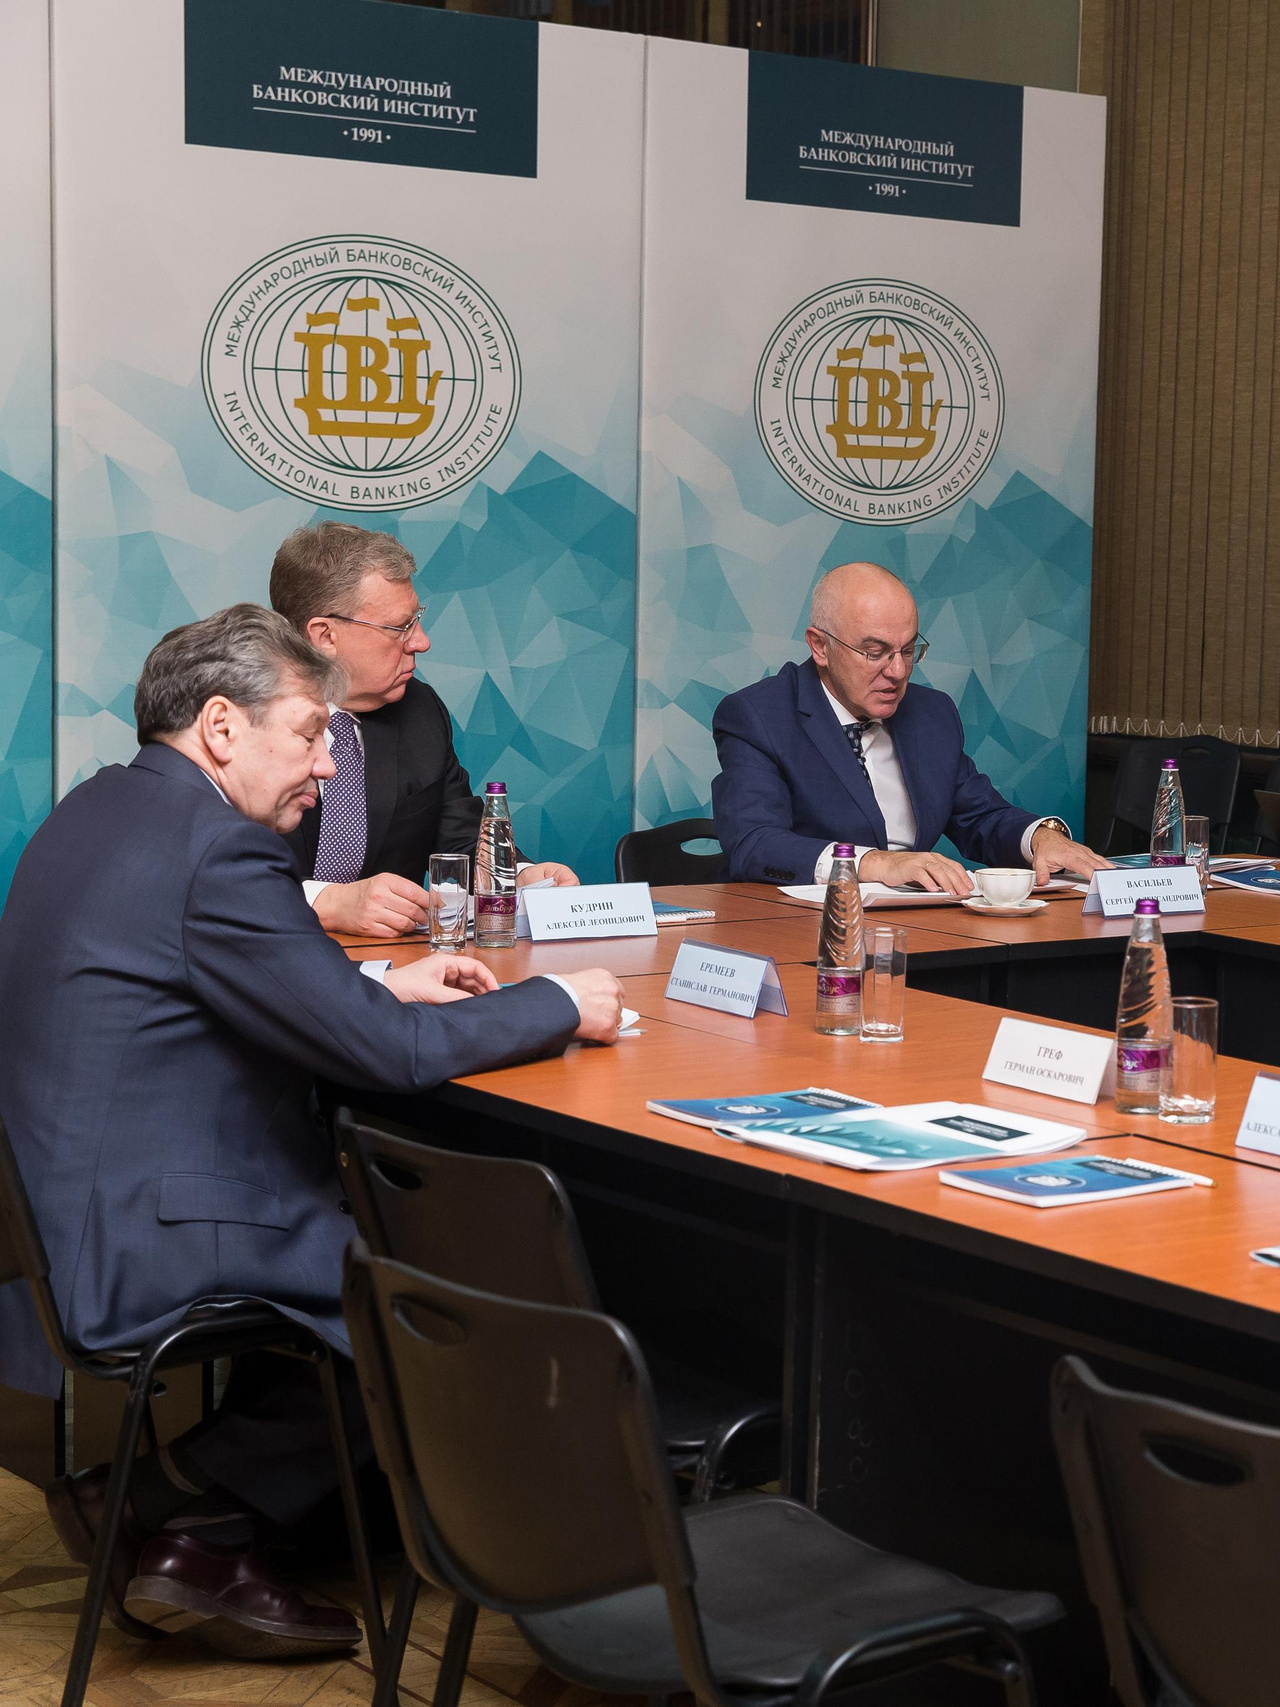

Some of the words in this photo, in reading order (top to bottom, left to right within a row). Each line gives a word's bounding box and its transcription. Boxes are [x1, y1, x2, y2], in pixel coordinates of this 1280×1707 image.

[278, 65, 453, 100] МЕЖДУНАРОДНЫЙ
[251, 84, 381, 112] БАНКОВСКИЙ
[382, 98, 478, 125] ИНСТИТУТ
[351, 127, 384, 144] 1991
[819, 129, 956, 158] МЕЖДУНАРОДНЫЙ
[799, 145, 898, 170] БАНКОВСКИЙ
[899, 157, 975, 180] ИНСТИТУТ
[874, 183, 901, 197] 1991
[223, 246, 342, 358] МЕЖДУНАРОДНЫЙ
[345, 247, 457, 294] БАНКОВСКИЙ
[455, 289, 503, 375] ИНСТИТУТ
[770, 289, 866, 390] МЕЖДУНАРОДНЫЙ
[868, 290, 956, 331] БАНКОВСКИЙ
[952, 327, 991, 402] ИНСТИТУТ
[222, 389, 342, 499] INTERNATIONAL
[348, 475, 433, 500] BANKING
[435, 402, 504, 484] INSTITUTE
[769, 418, 862, 514] INTERNATIONAL
[866, 494, 934, 516] BANKING
[936, 427, 991, 500] INSTITUTE
[1126, 878, 1173, 889] ВАСИЛЬЕВ
[570, 901, 614, 913] КУДРИН
[1105, 896, 1135, 906] СЕРГЕЙ
[1137, 893, 1199, 902] САНДРОВИЧ
[545, 917, 587, 931] АЛЕКСЕЙ
[588, 914, 646, 928] ЛЕОНИДОВИЧ
[699, 961, 736, 979] ЕРЕМЕЕВ
[670, 977, 708, 993] СТАНИСЛАВ
[708, 985, 755, 1005] ГЕРМАНОВИЧ
[1037, 1046, 1063, 1061] ГРЕФ
[1004, 1060, 1036, 1076] ГЕРМАН
[1036, 1066, 1085, 1086] ОСКАРОВИЧ
